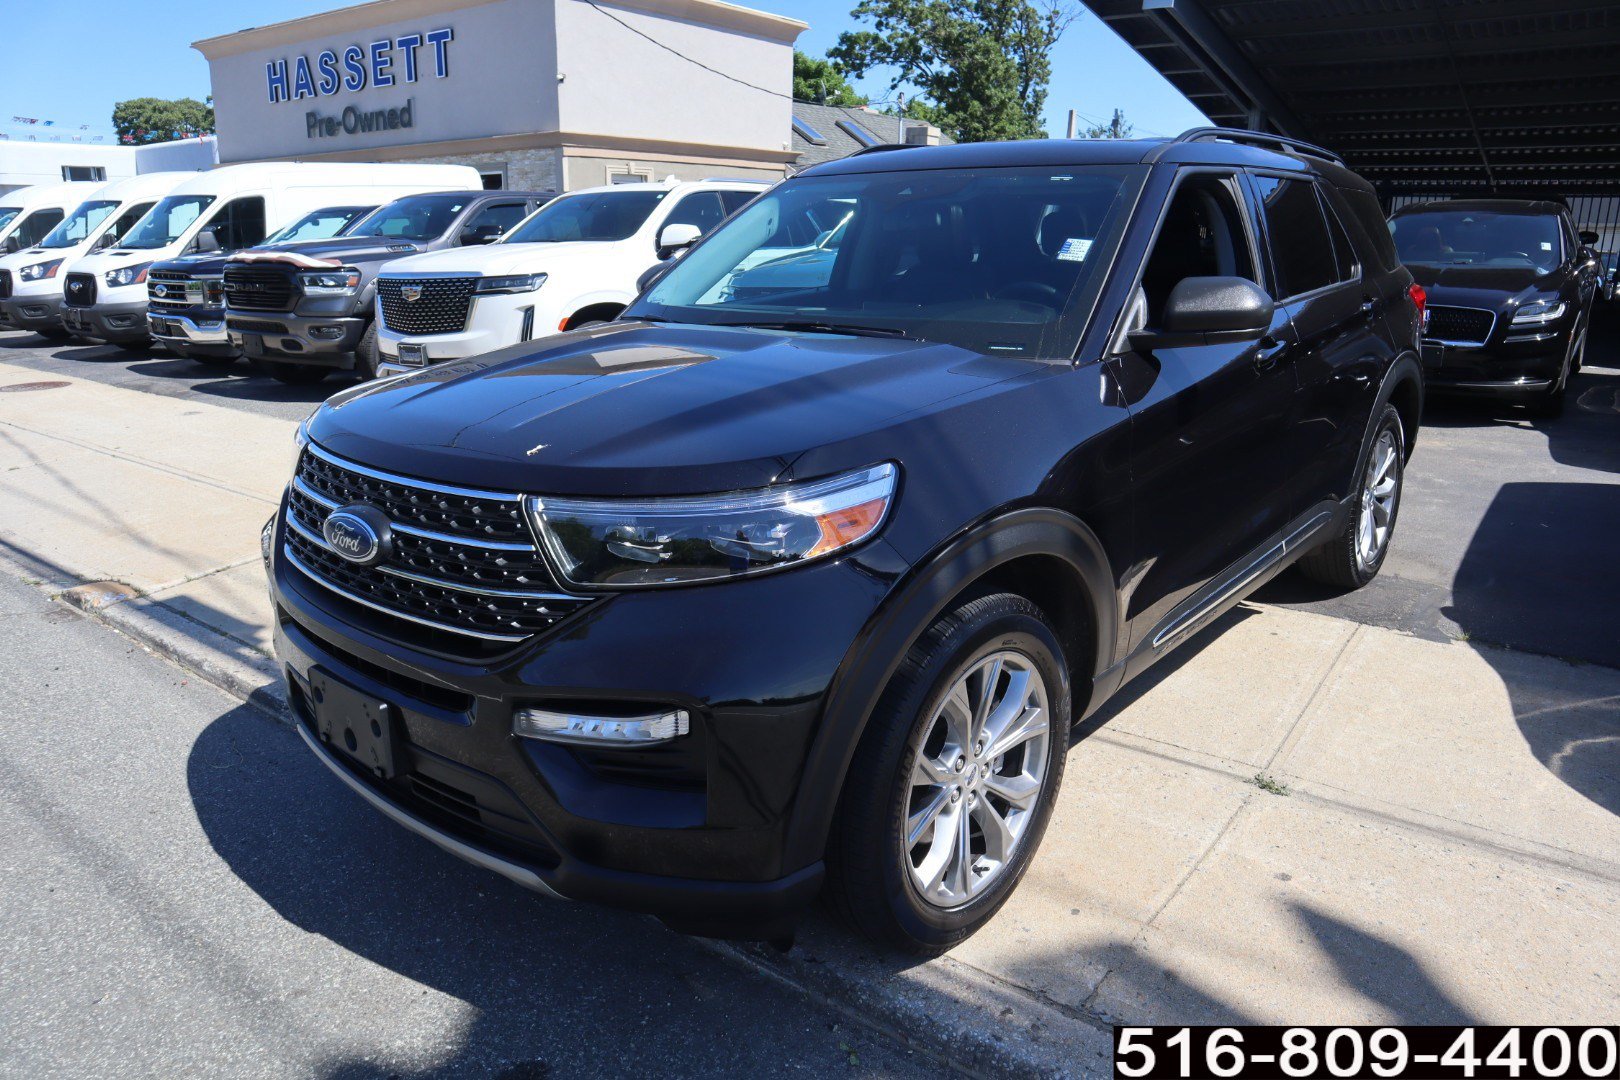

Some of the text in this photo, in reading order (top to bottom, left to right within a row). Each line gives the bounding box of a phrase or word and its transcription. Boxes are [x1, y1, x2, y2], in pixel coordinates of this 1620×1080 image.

[266, 28, 453, 104] HASSETT
[306, 98, 413, 139] Pre-Owned
[331, 521, 361, 552] Ford
